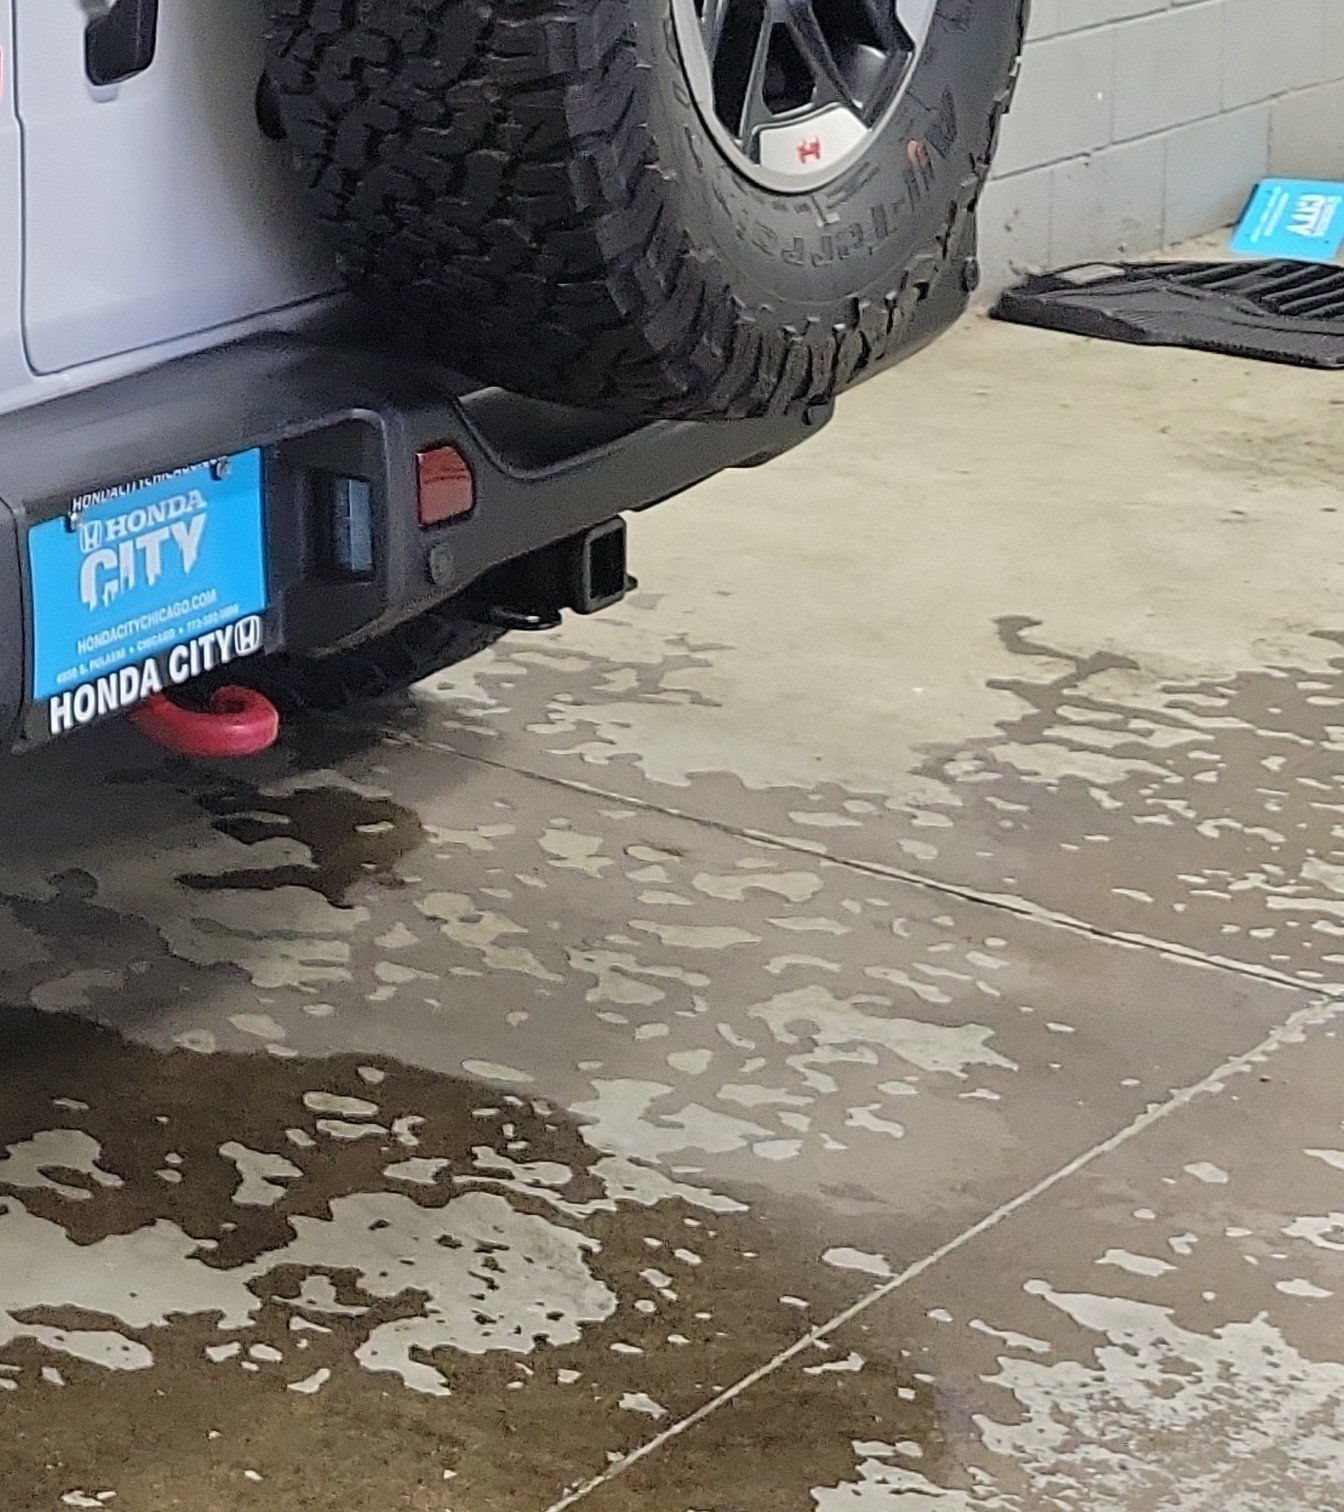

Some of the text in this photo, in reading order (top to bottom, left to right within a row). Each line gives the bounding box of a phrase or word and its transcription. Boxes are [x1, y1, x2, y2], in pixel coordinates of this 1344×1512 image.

[105, 489, 207, 536] HONDA
[80, 513, 207, 610] CITY
[77, 588, 218, 655] HONDACITYCHICAGO.COM
[50, 658, 161, 735] HONDA
[168, 624, 234, 685] CITY
